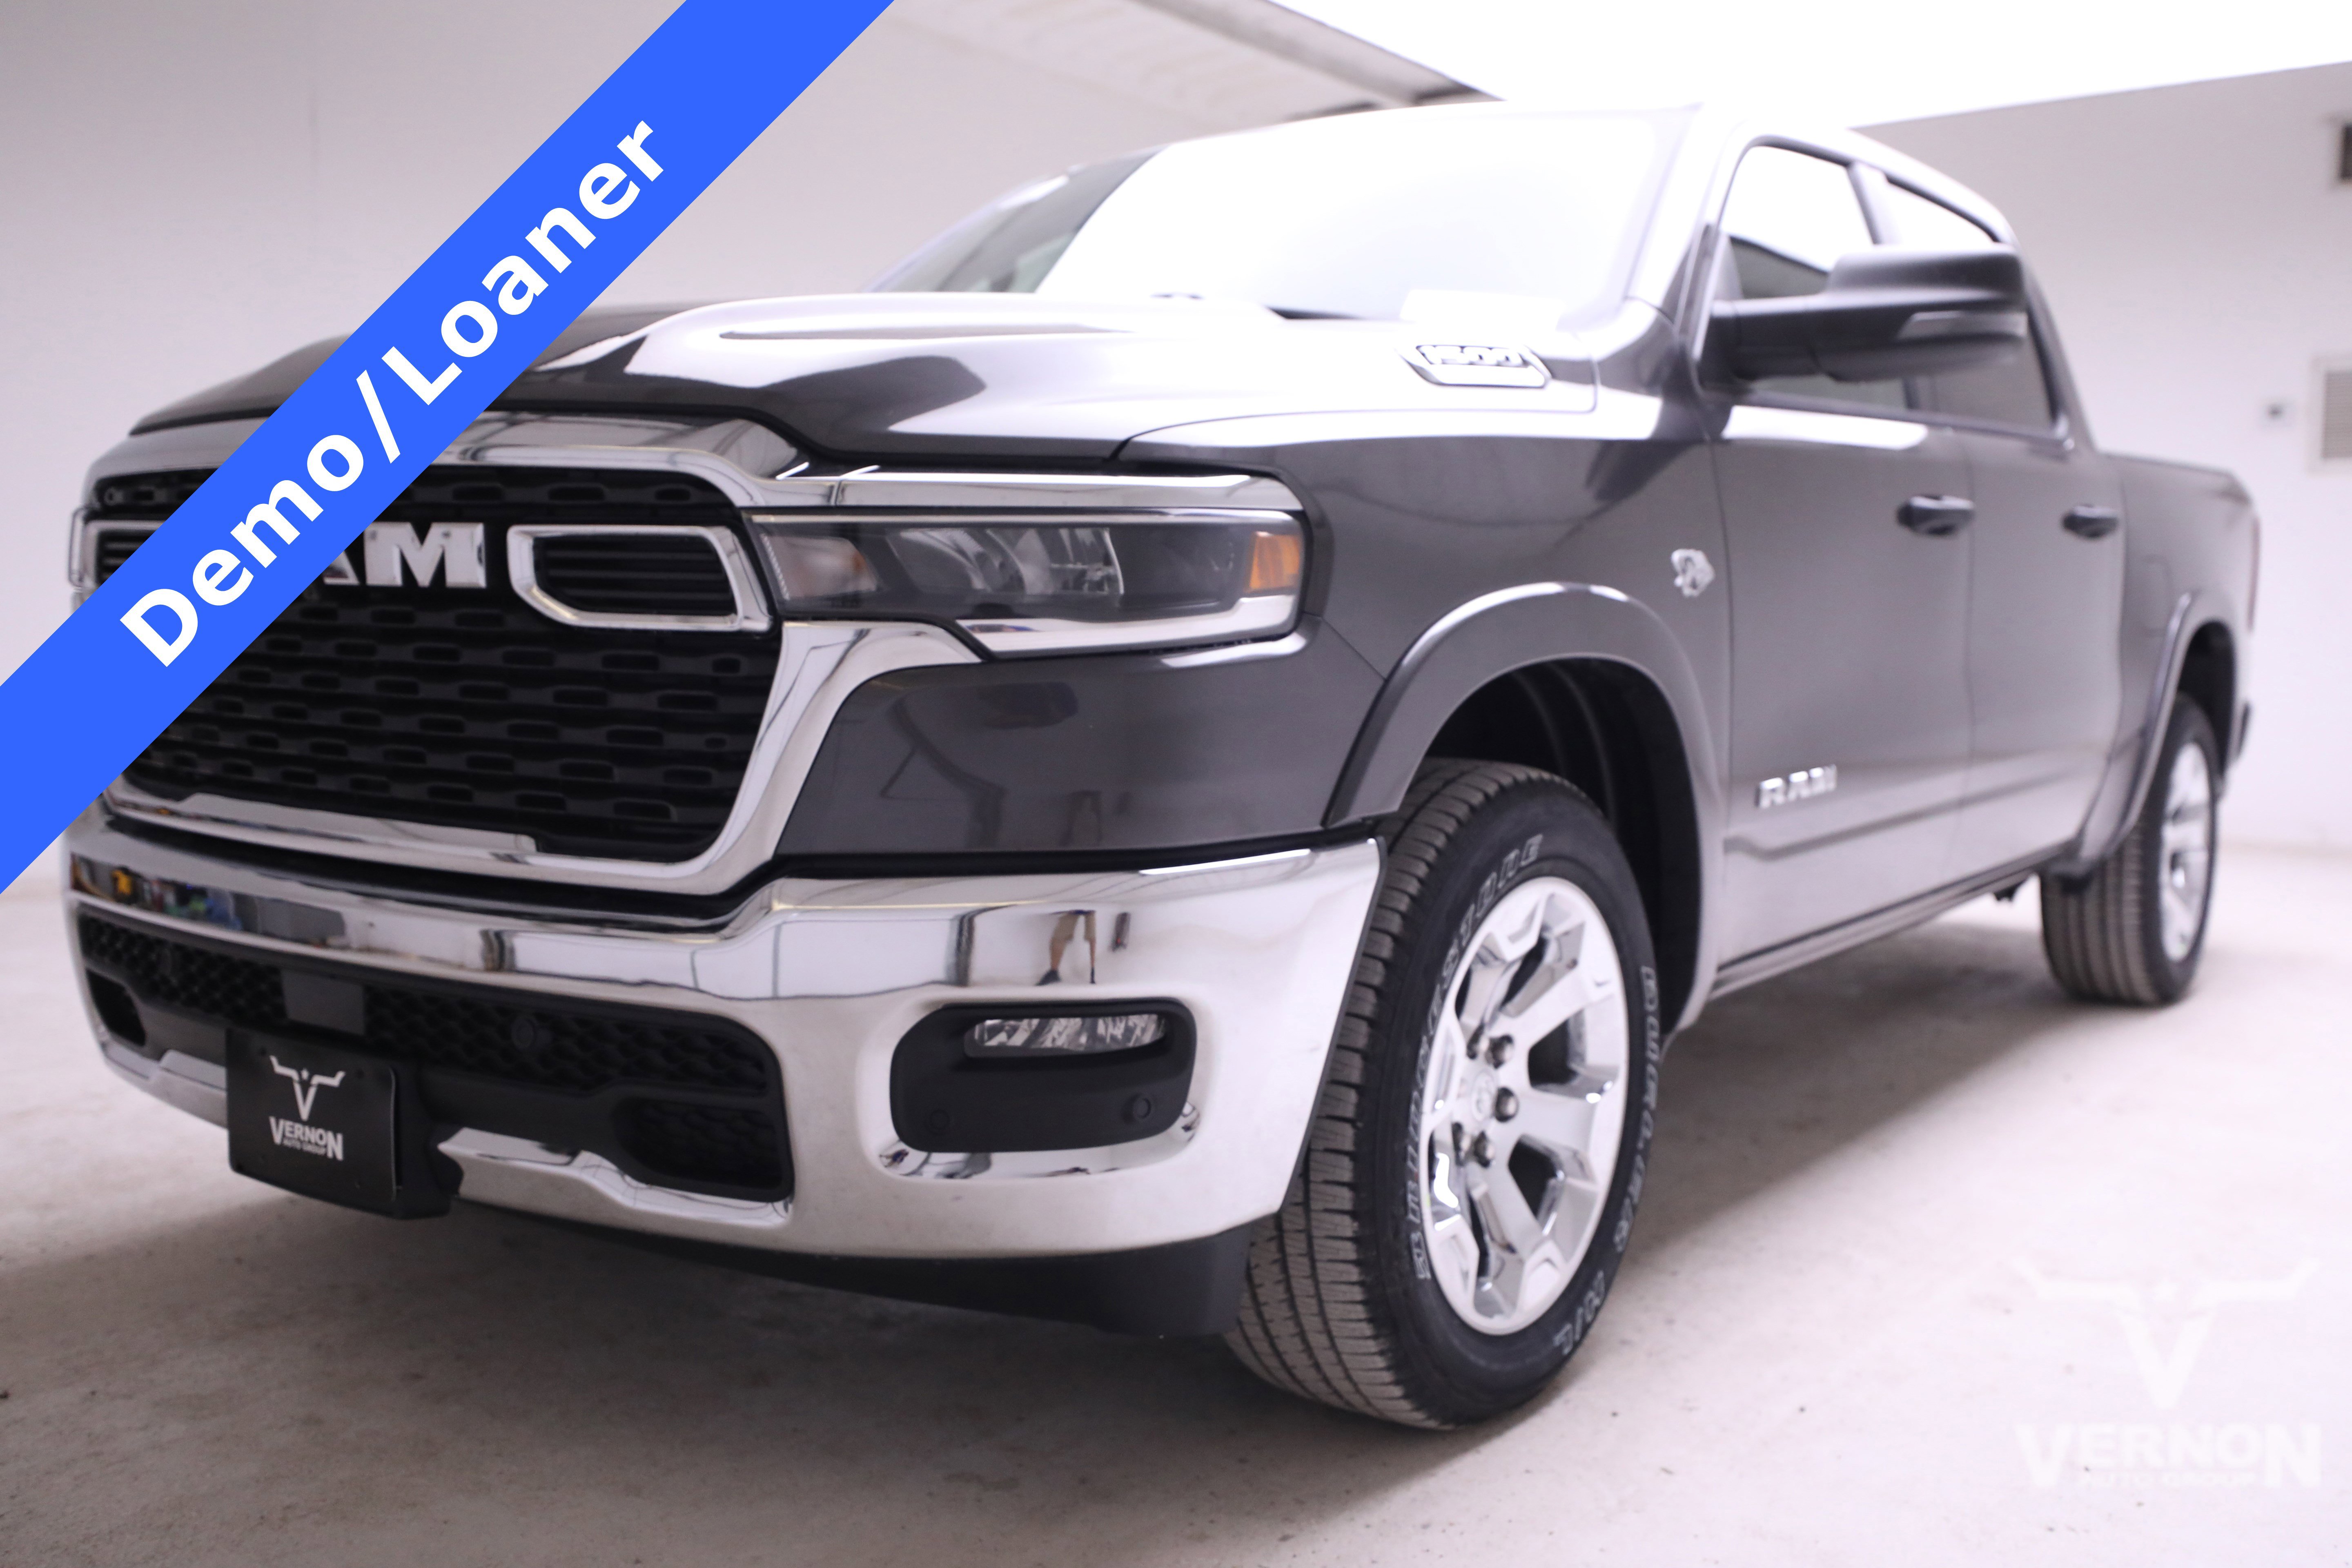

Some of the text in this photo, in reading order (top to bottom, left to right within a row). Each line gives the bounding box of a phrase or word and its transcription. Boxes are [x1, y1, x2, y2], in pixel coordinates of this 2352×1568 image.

[1418, 345, 1527, 367] 1500
[1759, 763, 1837, 809] RAM
[269, 1115, 344, 1162] VERNON
